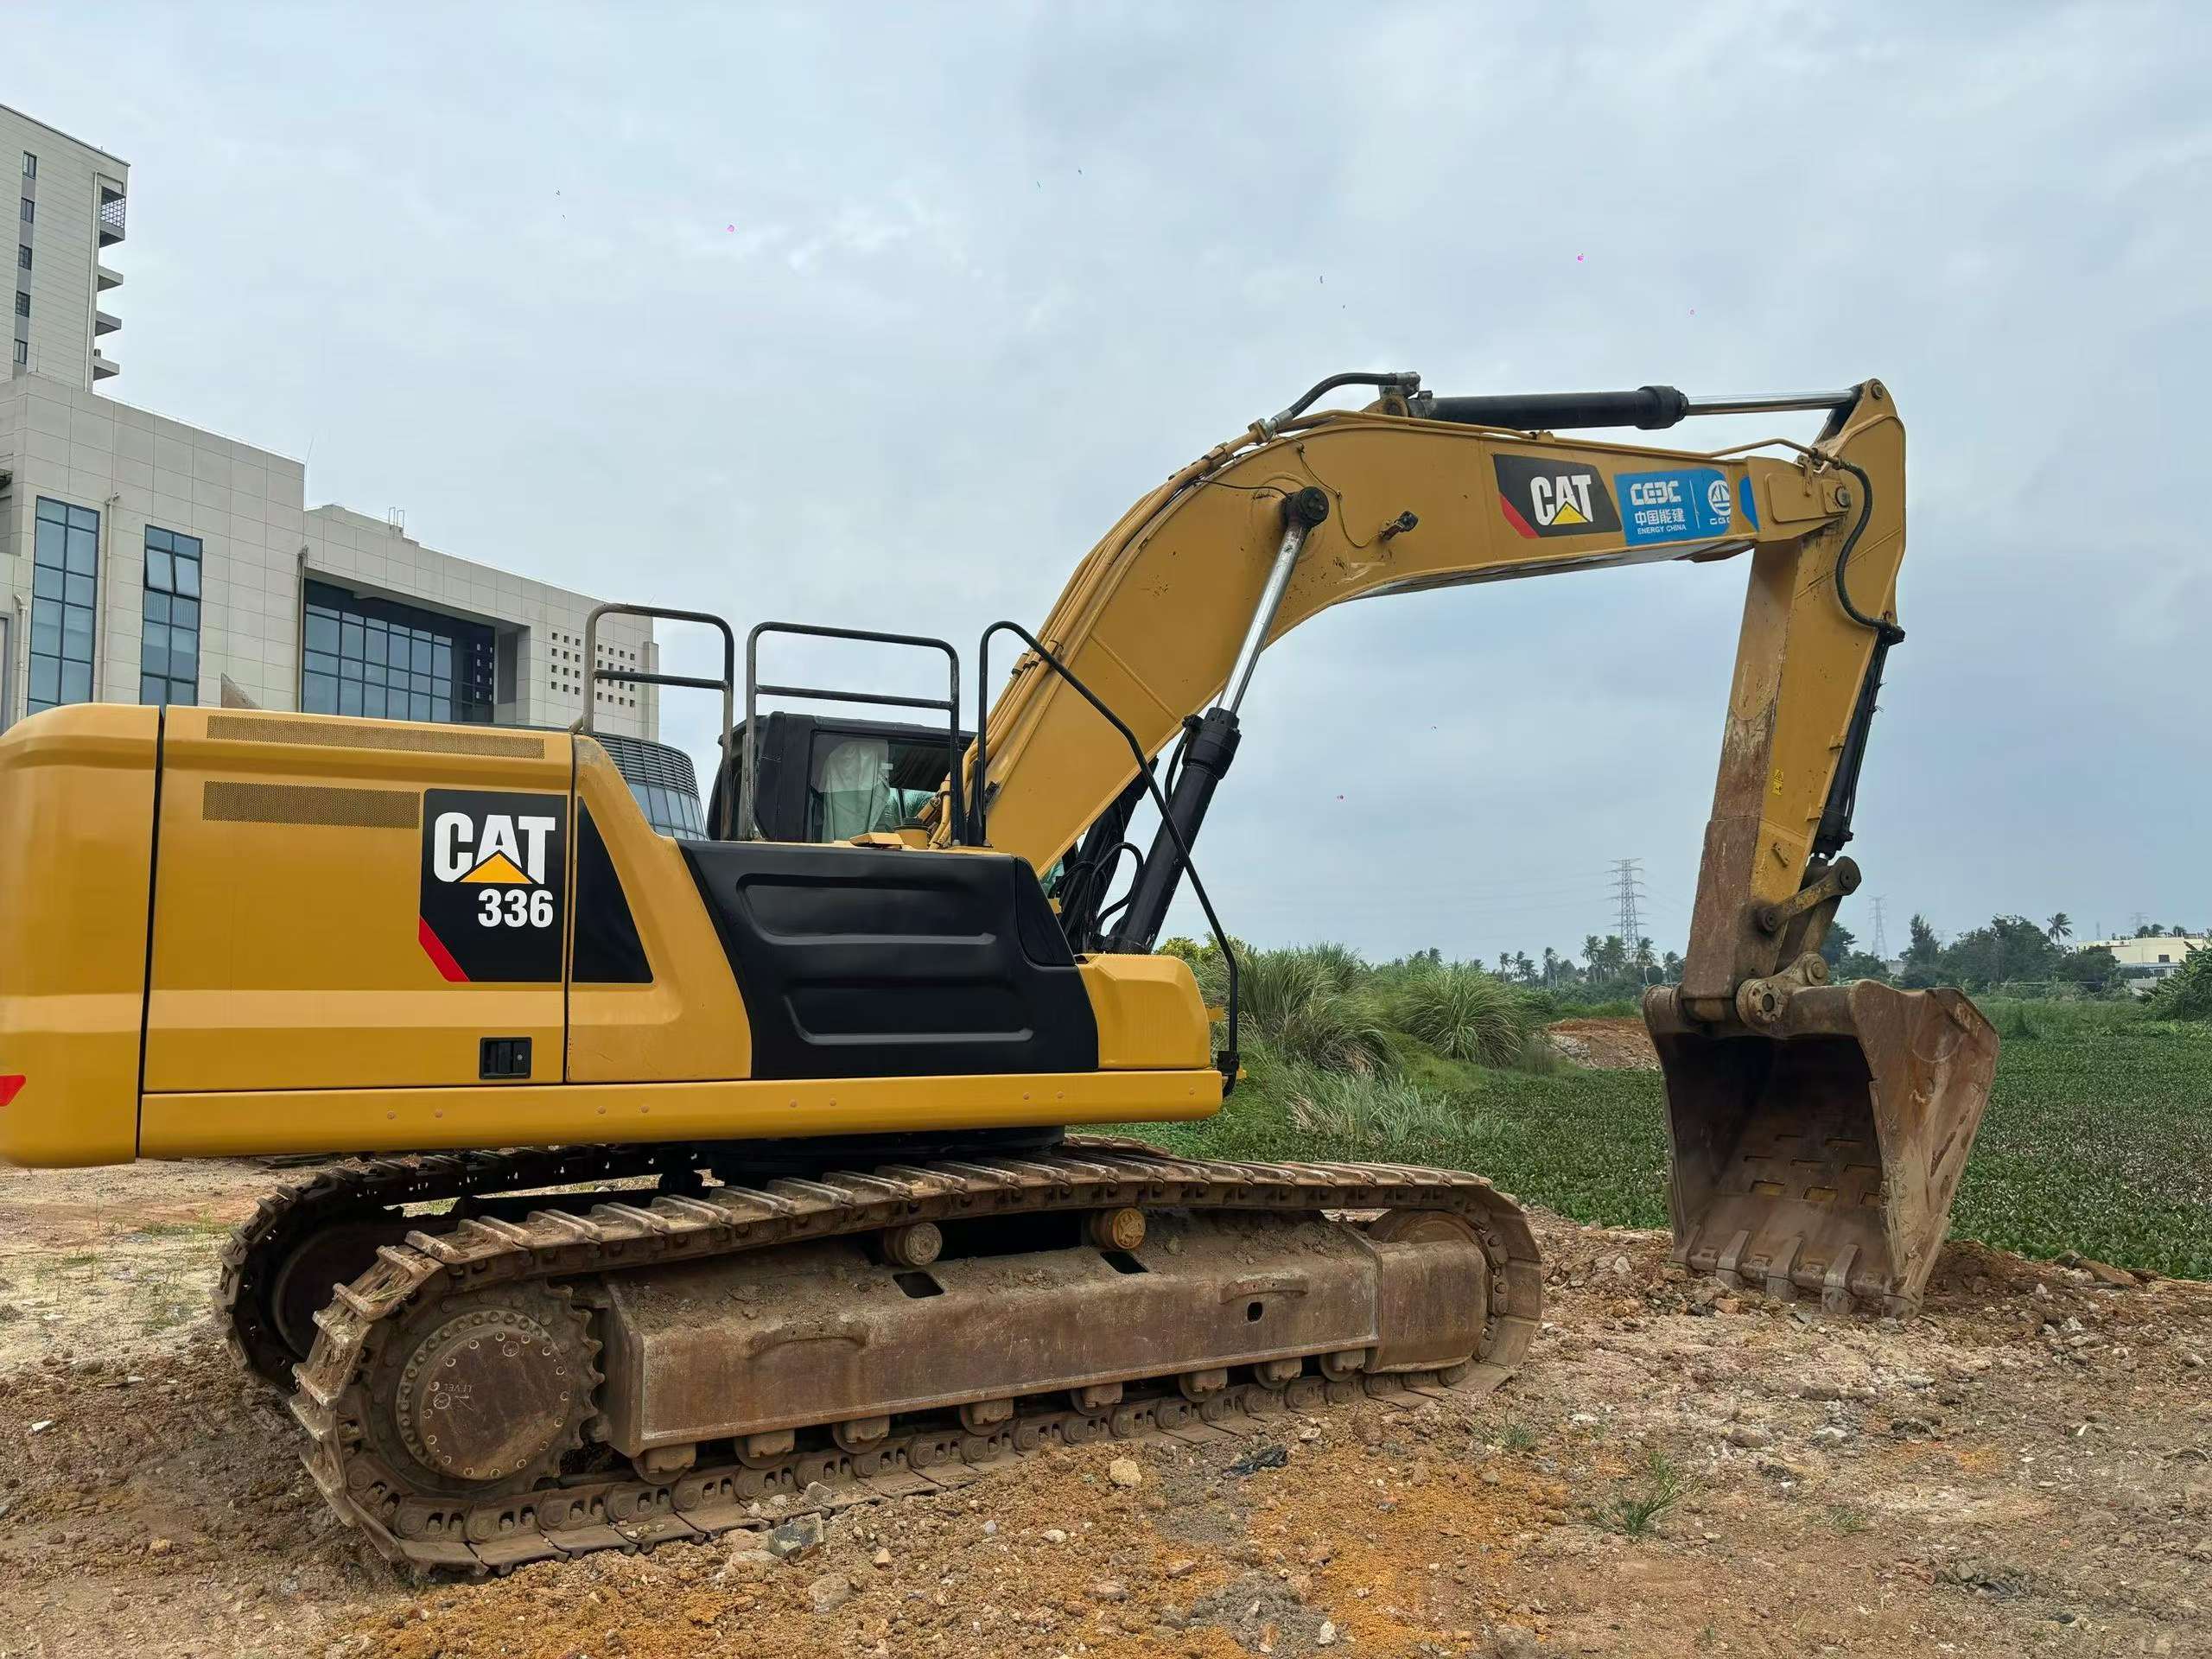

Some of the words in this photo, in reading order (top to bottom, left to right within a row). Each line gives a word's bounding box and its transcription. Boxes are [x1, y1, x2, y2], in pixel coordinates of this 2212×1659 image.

[1529, 474, 1594, 526] CAT
[1634, 507, 1686, 526] 中国能建
[1637, 526, 1664, 535] ENERGY
[1666, 524, 1688, 533] CHINA
[434, 811, 556, 885] CAT
[477, 888, 554, 928] 336
